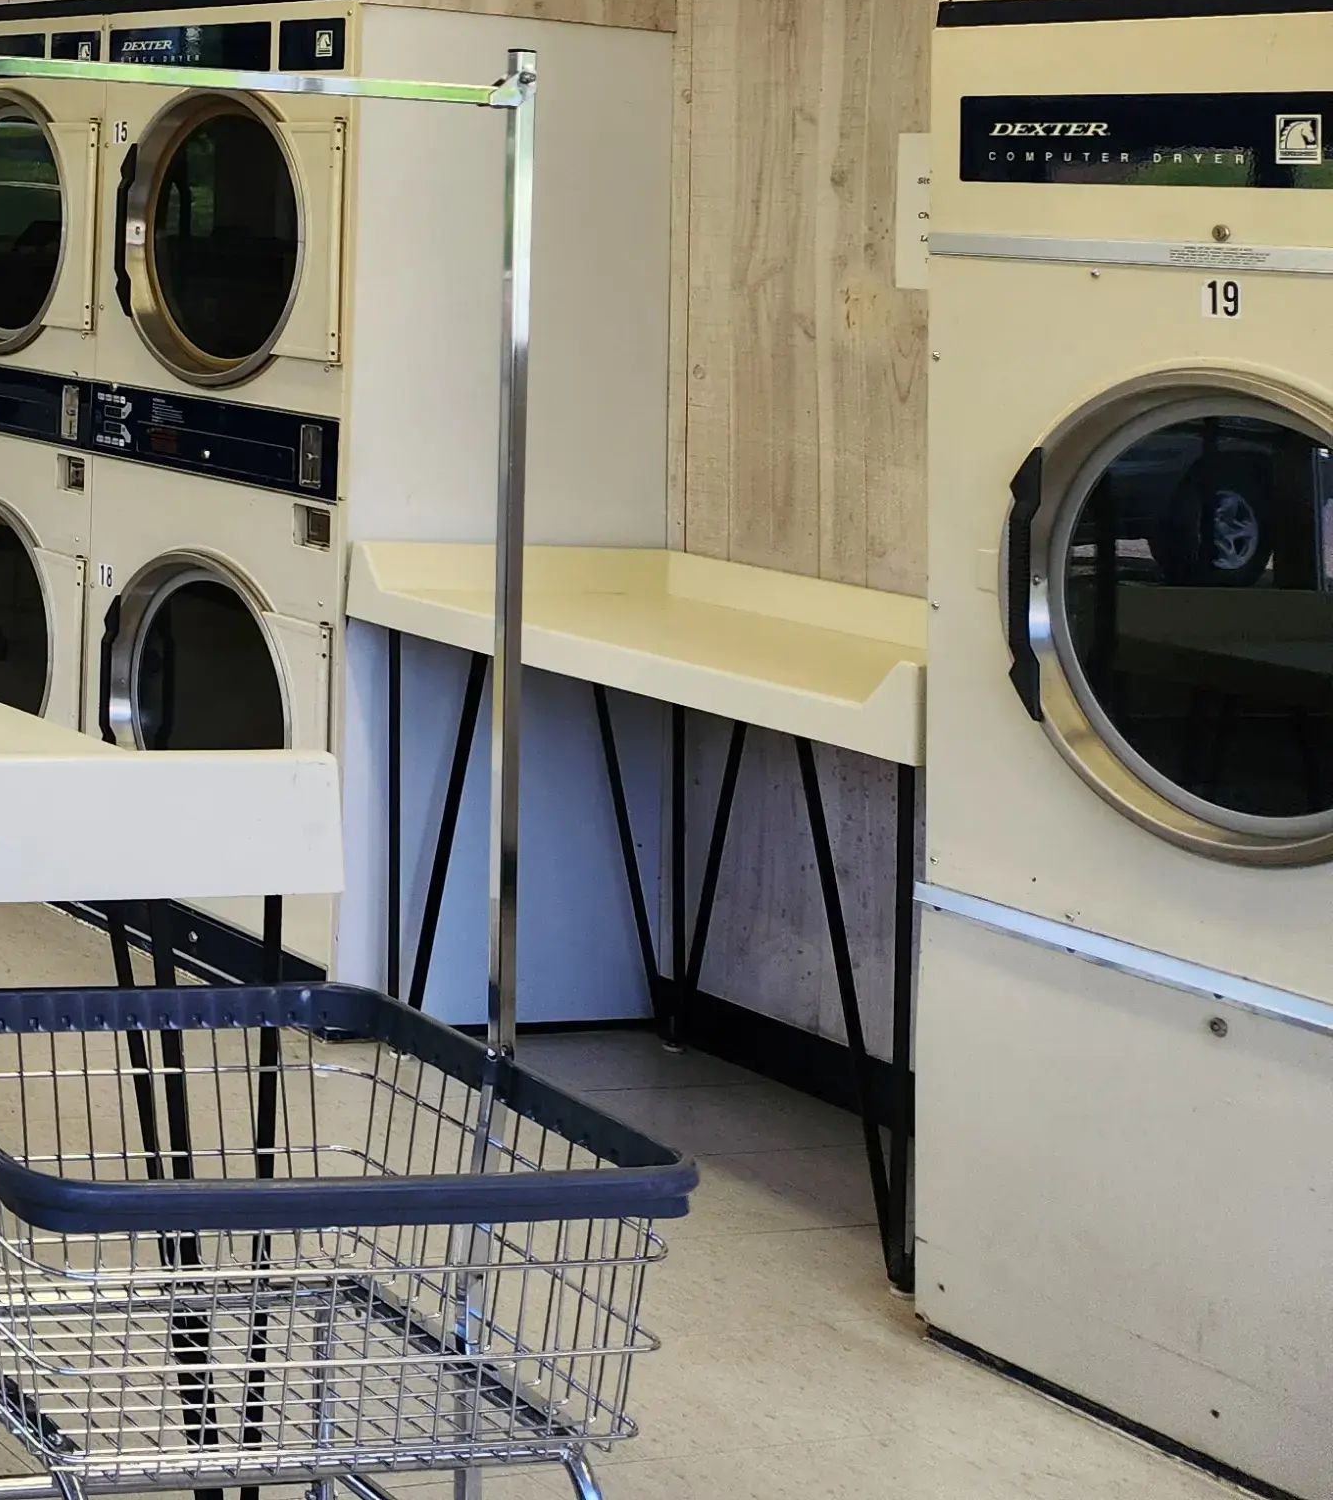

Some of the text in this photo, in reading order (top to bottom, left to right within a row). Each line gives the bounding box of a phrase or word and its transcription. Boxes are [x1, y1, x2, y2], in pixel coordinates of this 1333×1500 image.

[121, 39, 173, 51] DEXTER
[162, 54, 201, 62] DRYER
[115, 121, 128, 143] 15
[989, 122, 1110, 137] DEXTER
[988, 151, 1245, 165] COMPUTER DRYER
[1207, 280, 1239, 317] 19
[100, 564, 112, 588] 18
